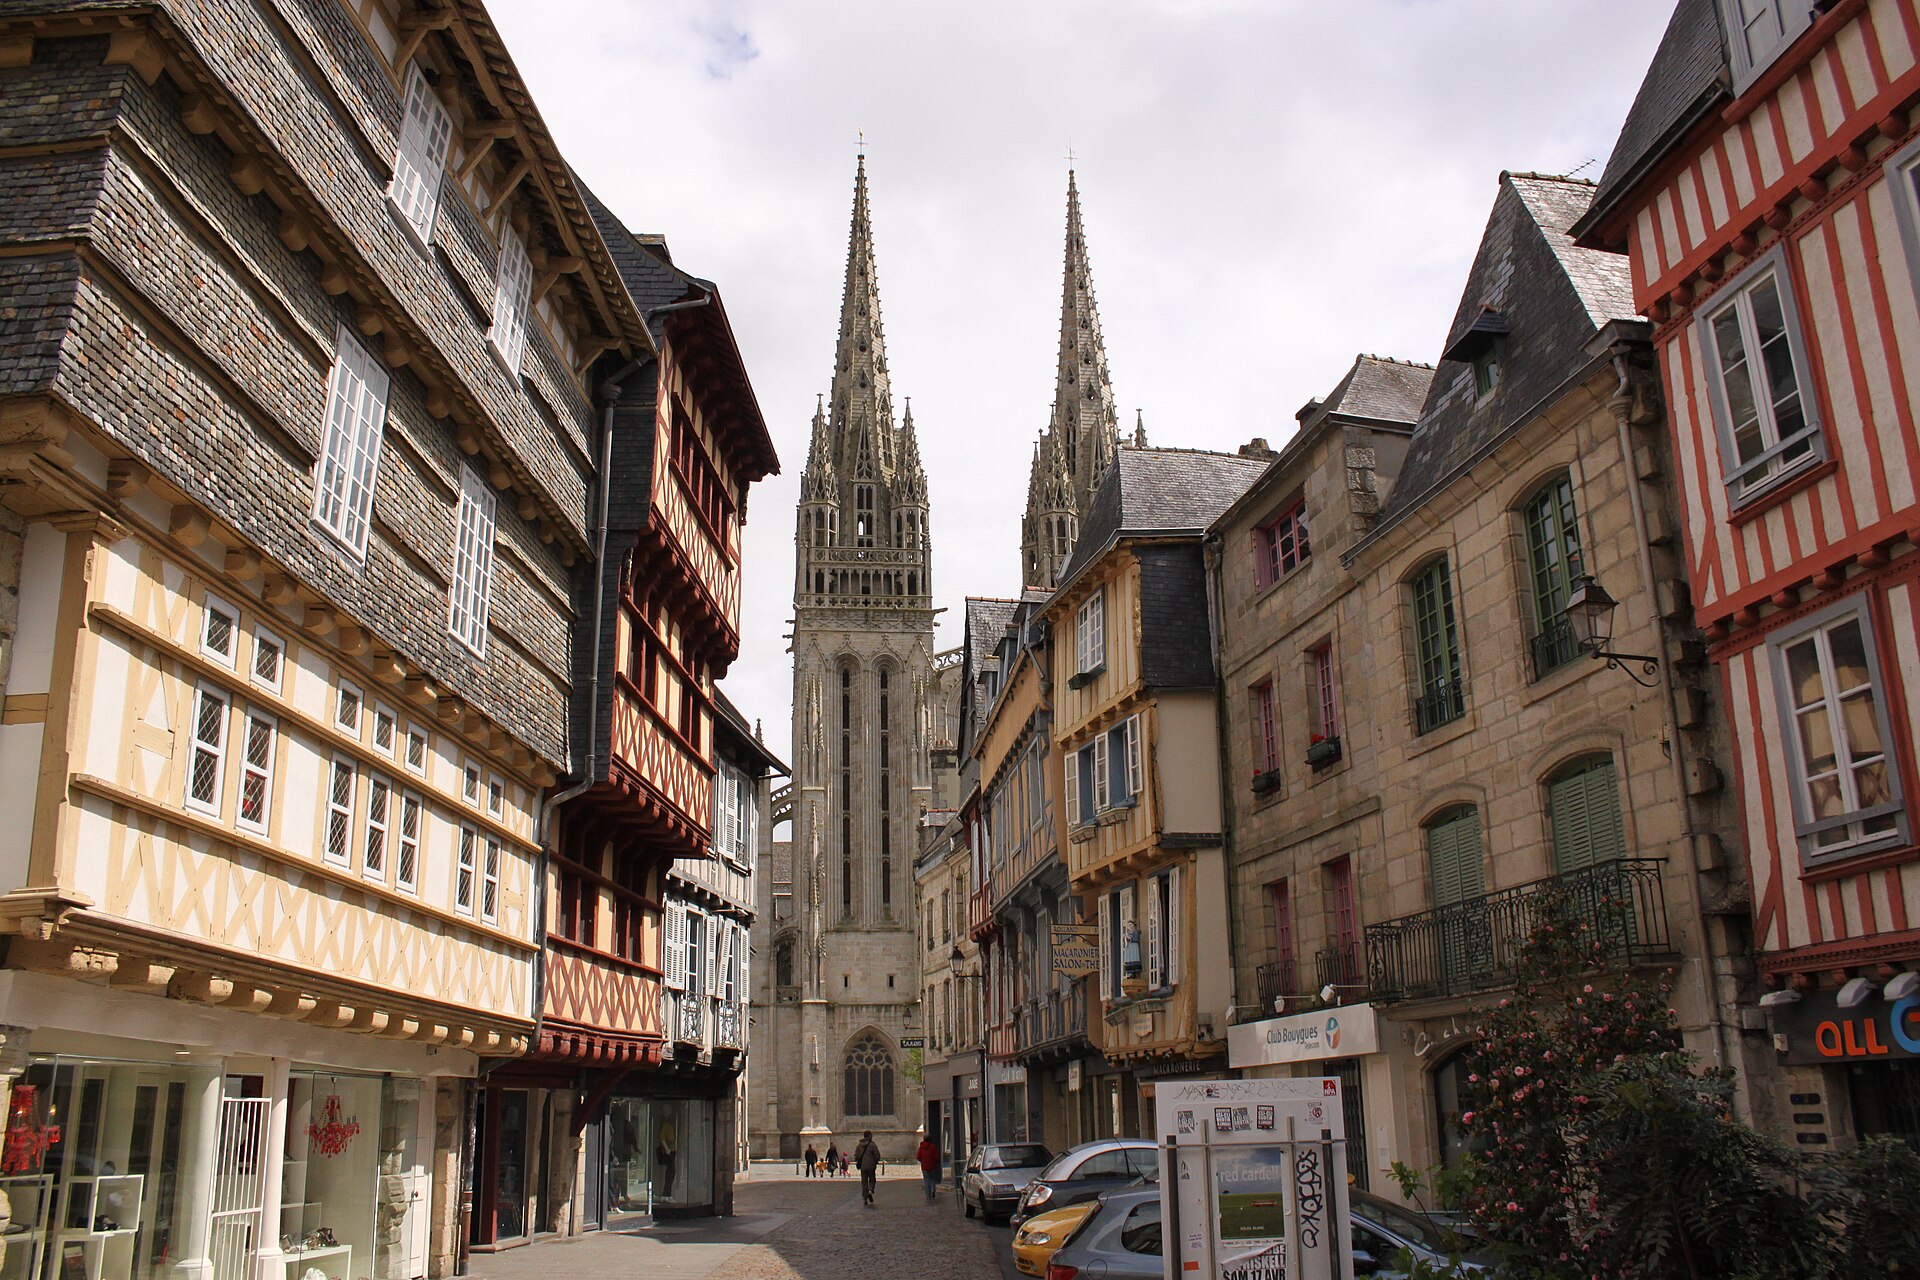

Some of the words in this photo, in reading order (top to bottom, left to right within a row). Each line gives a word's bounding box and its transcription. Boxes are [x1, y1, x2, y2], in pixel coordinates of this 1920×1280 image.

[1054, 958, 1081, 969] SALON
[1266, 1030, 1281, 1044] Club
[1282, 1025, 1318, 1045] Bouygues
[1304, 1041, 1320, 1050] Telecom
[1153, 1060, 1200, 1074] MACARONERIE
[1219, 1167, 1239, 1182] red
[1241, 1165, 1280, 1181] cardell
[1222, 1269, 1248, 1280] SAM
[1251, 1270, 1262, 1280] 17
[1265, 1269, 1286, 1280] AVR
